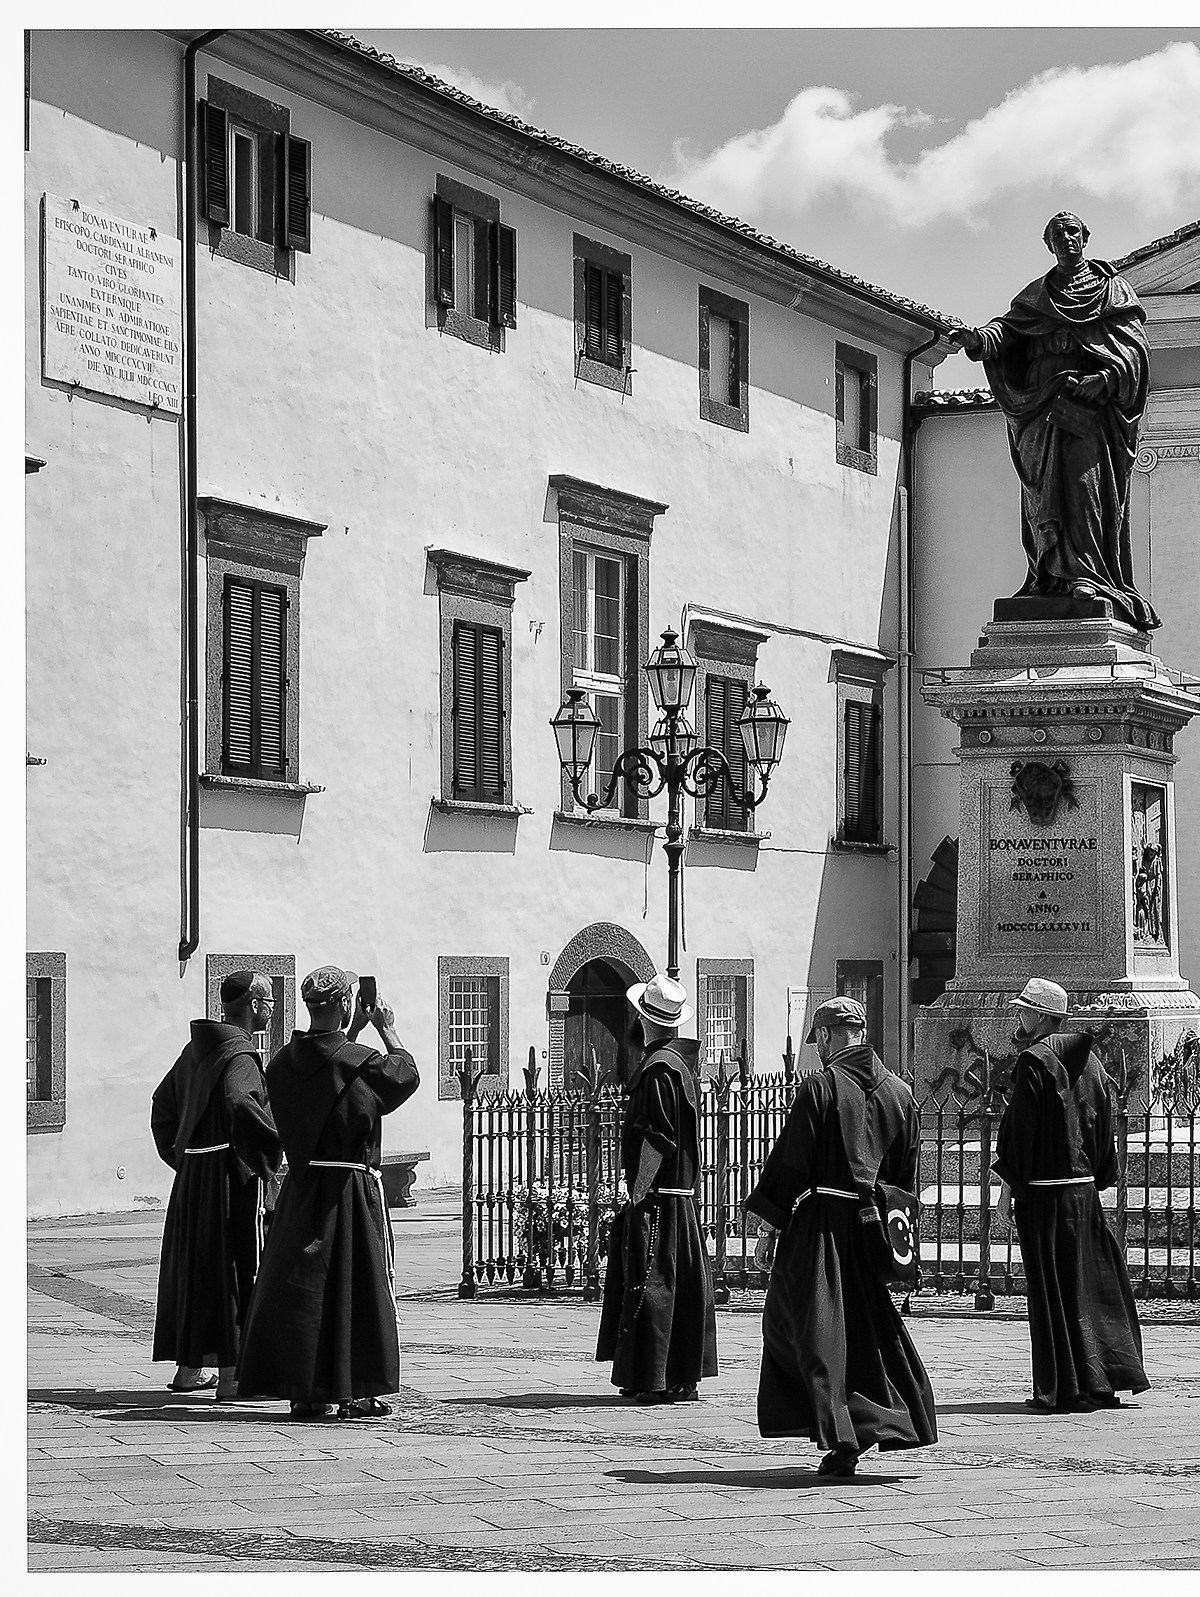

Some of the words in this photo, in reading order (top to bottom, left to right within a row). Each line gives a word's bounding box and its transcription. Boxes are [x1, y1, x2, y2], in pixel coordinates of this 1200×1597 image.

[82, 211, 148, 245] BONAVENTURAE
[76, 239, 111, 260] DOCTORI
[114, 253, 155, 275] SERAPHICO
[105, 264, 127, 279] CIVES
[91, 287, 141, 313] EXTERNIQUE
[118, 282, 164, 305] GLORIANTES
[111, 324, 162, 347] SANCTIMONIAE
[119, 312, 169, 336] ADMIRATIONE
[121, 341, 174, 365] DEDICAVERUNT
[990, 838, 1097, 850] BONAVENTVRAE
[1018, 858, 1068, 867] DOCTORI
[1012, 872, 1074, 881] SERAPHICO
[1027, 904, 1060, 913] ANNO
